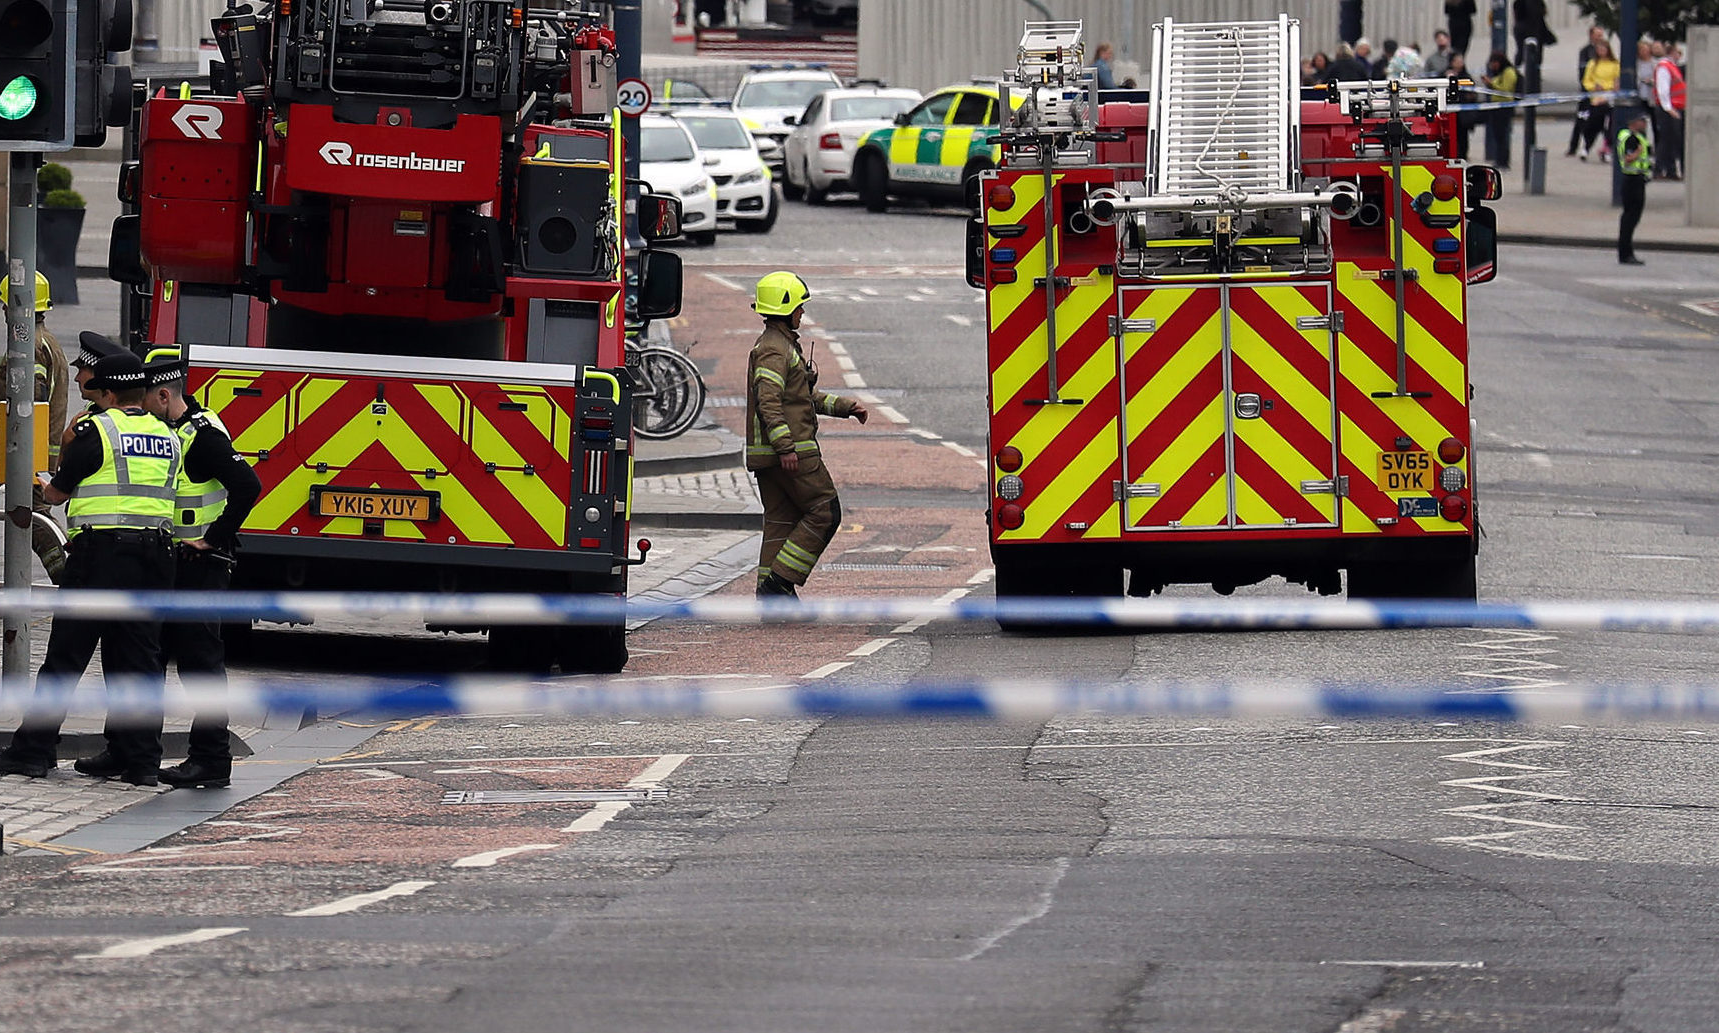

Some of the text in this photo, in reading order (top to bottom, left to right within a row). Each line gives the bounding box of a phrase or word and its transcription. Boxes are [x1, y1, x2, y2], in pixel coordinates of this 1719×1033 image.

[619, 90, 646, 106] 20
[355, 152, 466, 172] rosenbauer
[122, 436, 172, 456] POLICE
[1381, 453, 1429, 470] SV65
[1388, 472, 1424, 489] OYK
[332, 495, 418, 516] YK16 XUY
